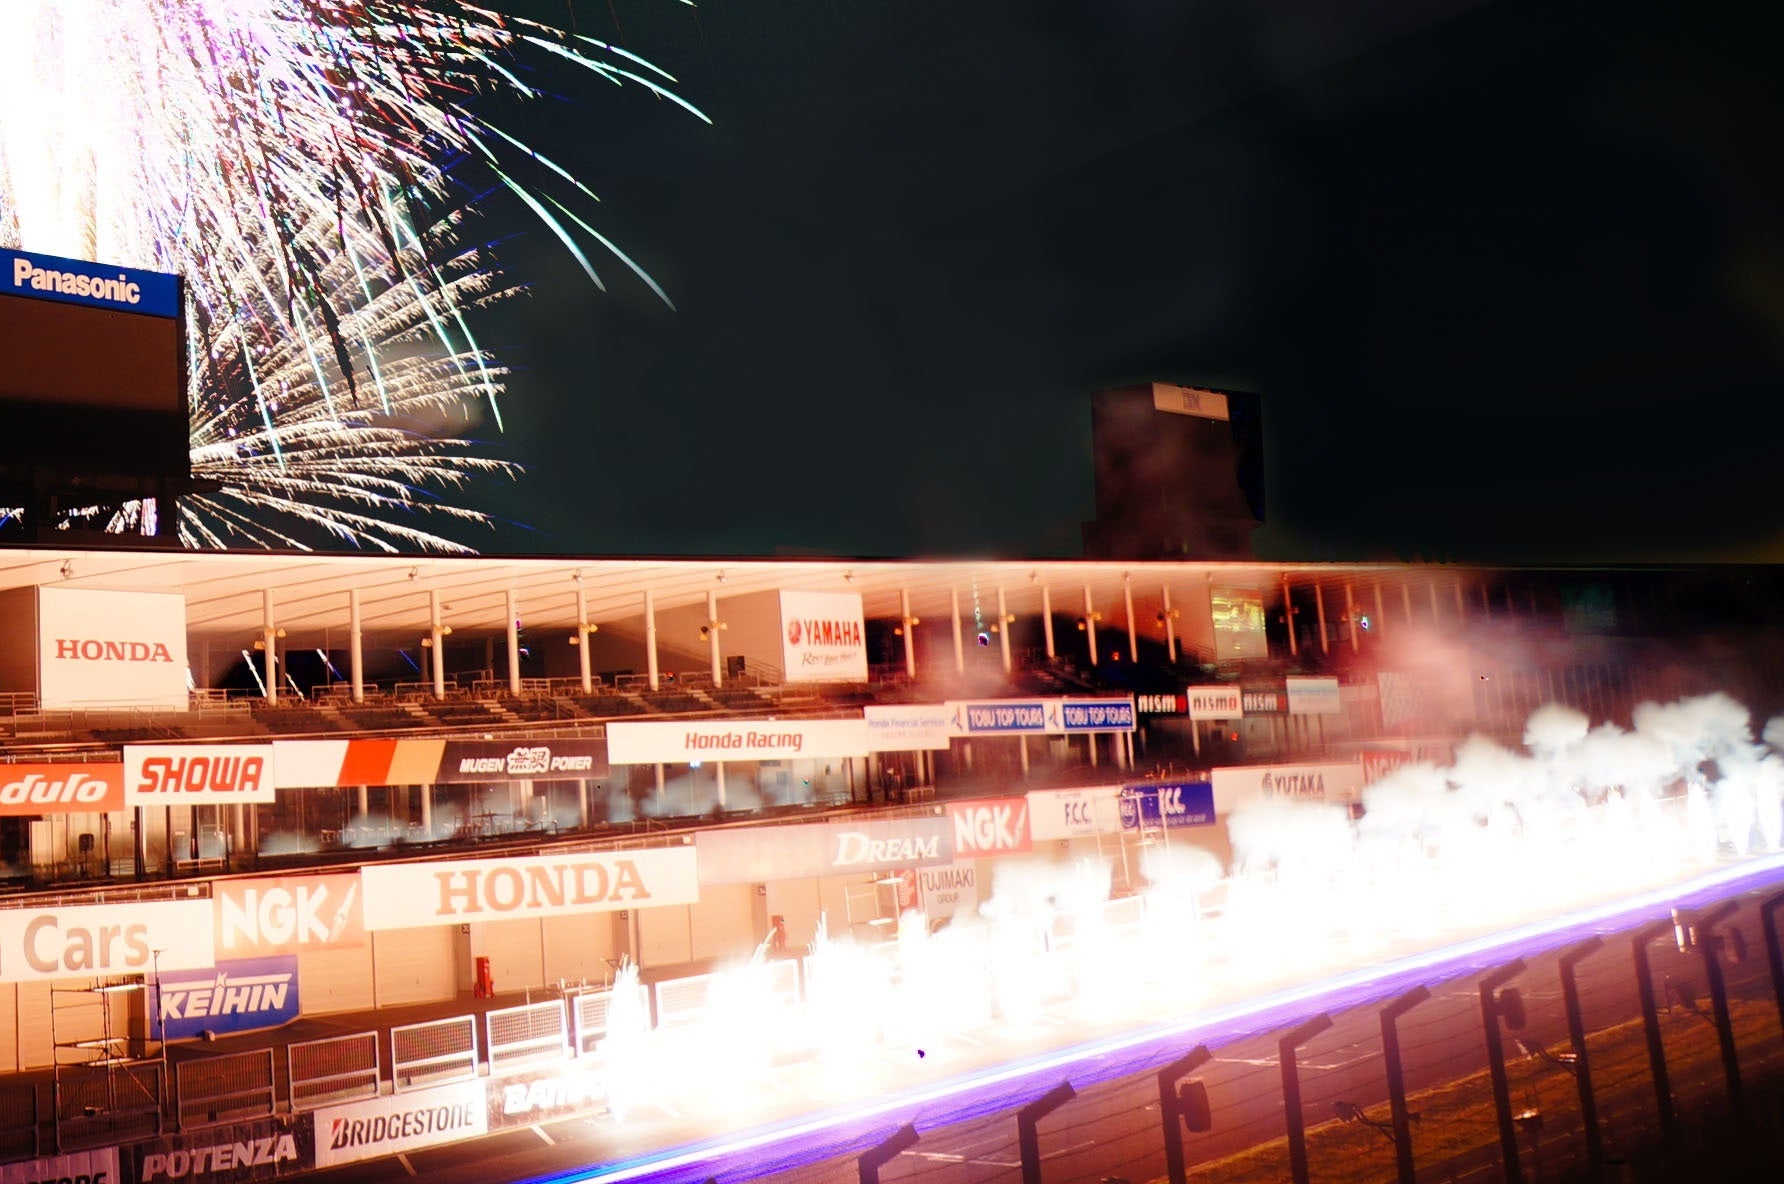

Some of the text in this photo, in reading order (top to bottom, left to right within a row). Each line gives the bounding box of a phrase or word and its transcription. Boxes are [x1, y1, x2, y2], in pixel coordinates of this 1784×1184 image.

[13, 258, 141, 304] Panasonic
[55, 638, 173, 663] HONDA
[804, 620, 861, 646] YAMAHA
[970, 707, 1043, 728] TOBU TOP TOURS
[1065, 705, 1132, 725] TOBU TOP TOURS
[685, 730, 803, 752] Honda Racing
[138, 756, 263, 793] SHOWA
[460, 758, 505, 773] MUGEN
[550, 756, 593, 771] POWER
[1275, 773, 1325, 794] YUTAKA
[832, 831, 940, 866] DREAM
[953, 811, 1015, 852] NGK
[435, 861, 652, 915] HONDA
[221, 883, 329, 948] NGK
[23, 914, 150, 973] Cars
[160, 972, 289, 1020] KEIHIN
[330, 1101, 475, 1150] BRIDGESTONE
[141, 1133, 298, 1182] POTENZA
